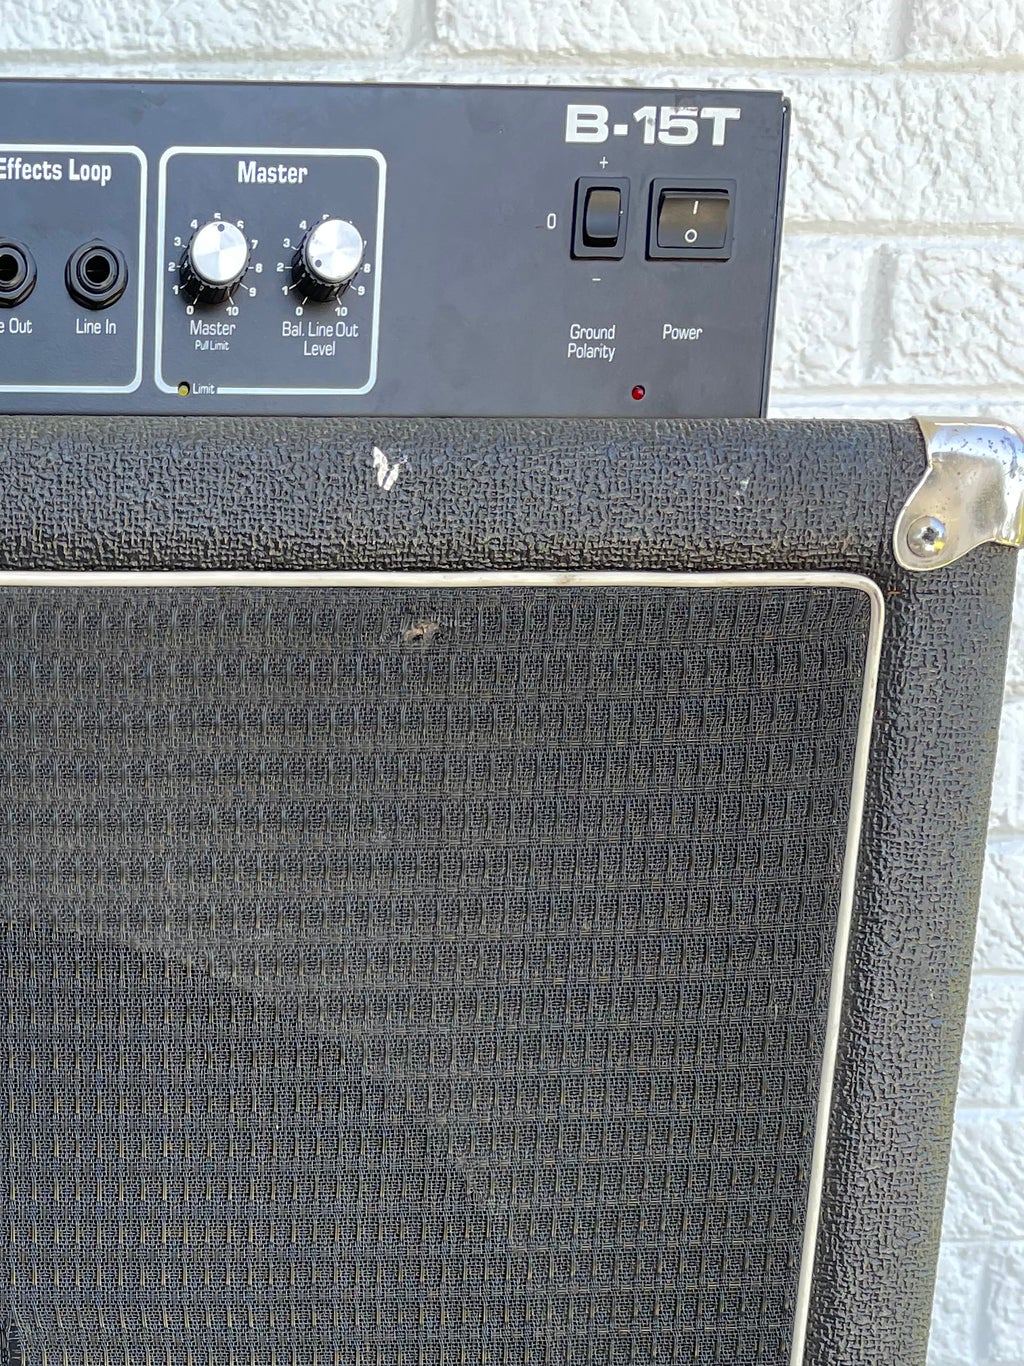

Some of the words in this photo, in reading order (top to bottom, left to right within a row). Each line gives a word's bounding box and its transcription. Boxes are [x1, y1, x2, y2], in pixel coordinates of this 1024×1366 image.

[565, 104, 741, 146] B-15T
[69, 159, 111, 186] Loop
[238, 161, 307, 185] Master
[191, 219, 197, 228] 4
[300, 221, 306, 229] 4
[174, 237, 181, 246] 3
[252, 240, 258, 249] 7
[283, 239, 290, 248] 3
[168, 263, 175, 271] 2
[256, 264, 262, 272] 8
[277, 263, 284, 271] 2
[364, 264, 371, 272] 8
[172, 286, 178, 294] 1
[249, 288, 256, 296] 9
[282, 286, 288, 295] 1
[358, 286, 365, 295] 9
[187, 305, 193, 314] 0
[226, 307, 239, 315] 10
[296, 307, 303, 315] 0
[335, 307, 347, 316] 10
[9, 318, 32, 334] Out
[76, 318, 101, 334] Line
[105, 319, 117, 334] In
[190, 320, 236, 335] Master
[282, 321, 304, 336] Bal.
[309, 322, 333, 337] Line
[336, 322, 358, 337] Out
[570, 324, 615, 340] Ground
[663, 325, 702, 340] Power
[195, 339, 209, 351] Pull
[210, 339, 229, 351] Limit
[304, 340, 336, 356] Level
[568, 343, 616, 362] Polarity
[193, 382, 215, 395] Limit
